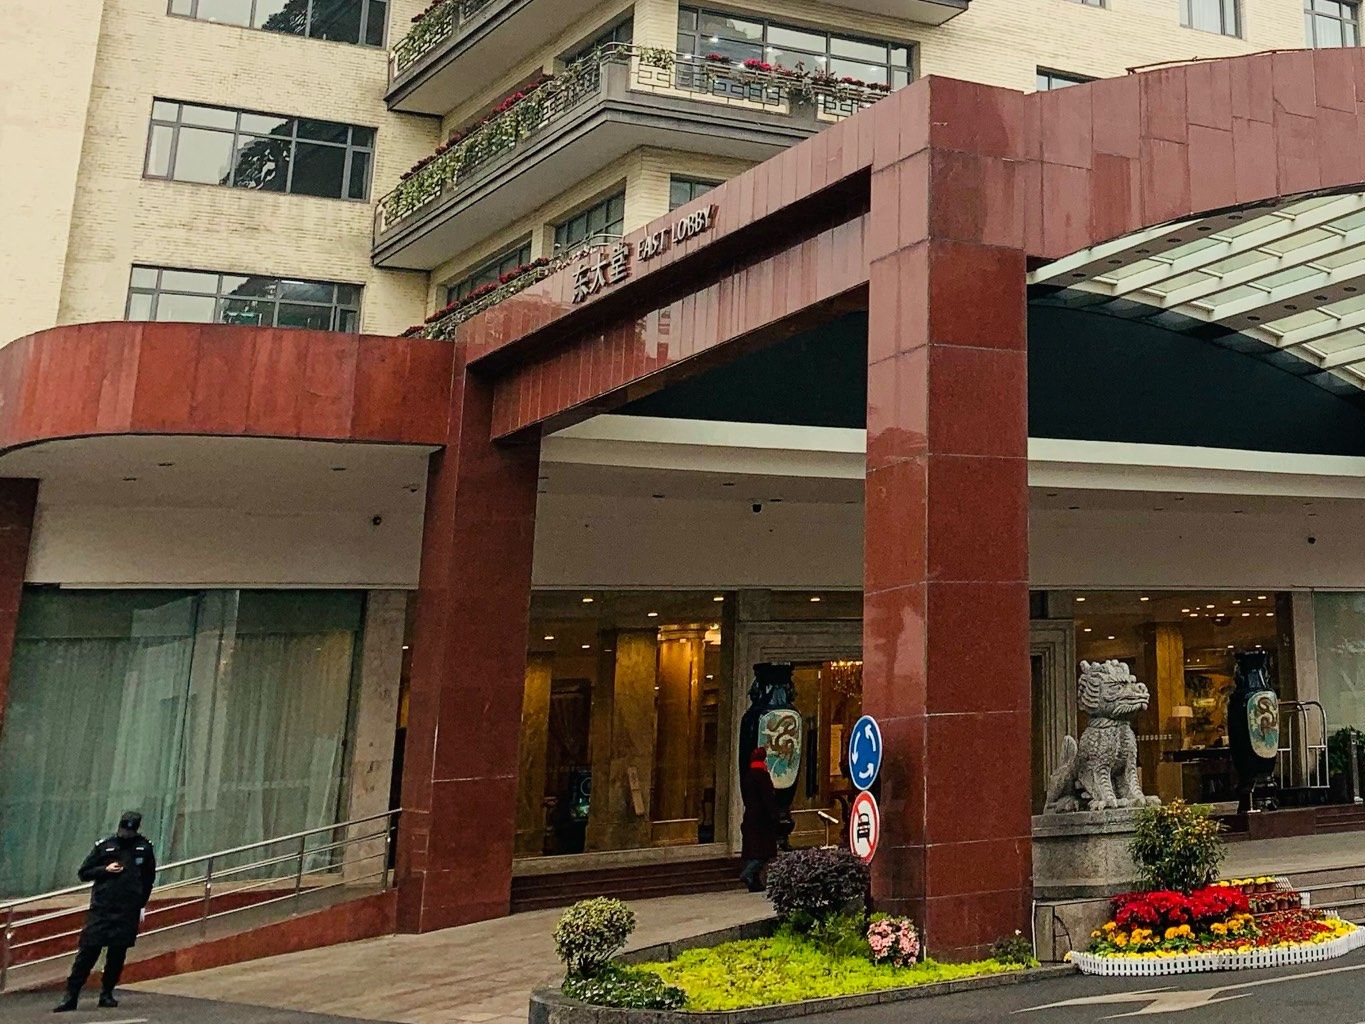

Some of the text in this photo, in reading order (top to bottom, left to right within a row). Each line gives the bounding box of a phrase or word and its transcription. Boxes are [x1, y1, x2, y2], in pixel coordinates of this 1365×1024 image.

[637, 204, 712, 261] EAST LOBBY
[572, 243, 630, 303] 东大堂
